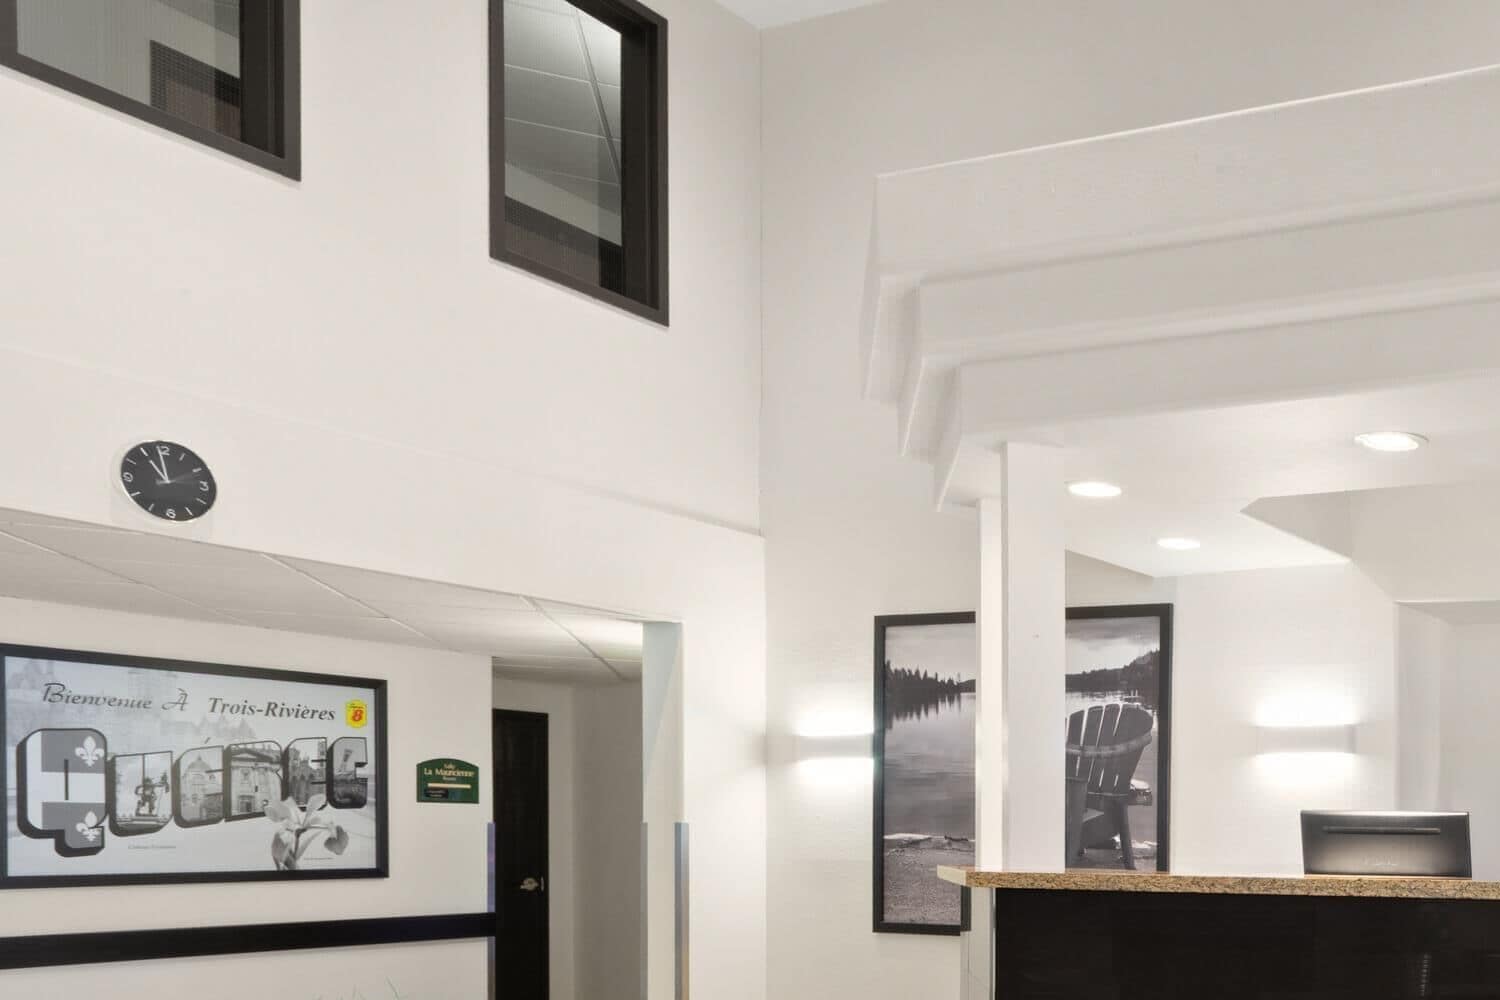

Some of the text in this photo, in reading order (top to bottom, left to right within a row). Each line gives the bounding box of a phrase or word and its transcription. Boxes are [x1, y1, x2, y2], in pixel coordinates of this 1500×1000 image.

[156, 446, 170, 456] 2
[122, 472, 133, 482] 9
[200, 481, 209, 491] 3
[166, 509, 176, 519] 6
[43, 682, 153, 710] Bienvenue
[208, 697, 336, 721] Trois-Rivières
[352, 709, 363, 722] 8
